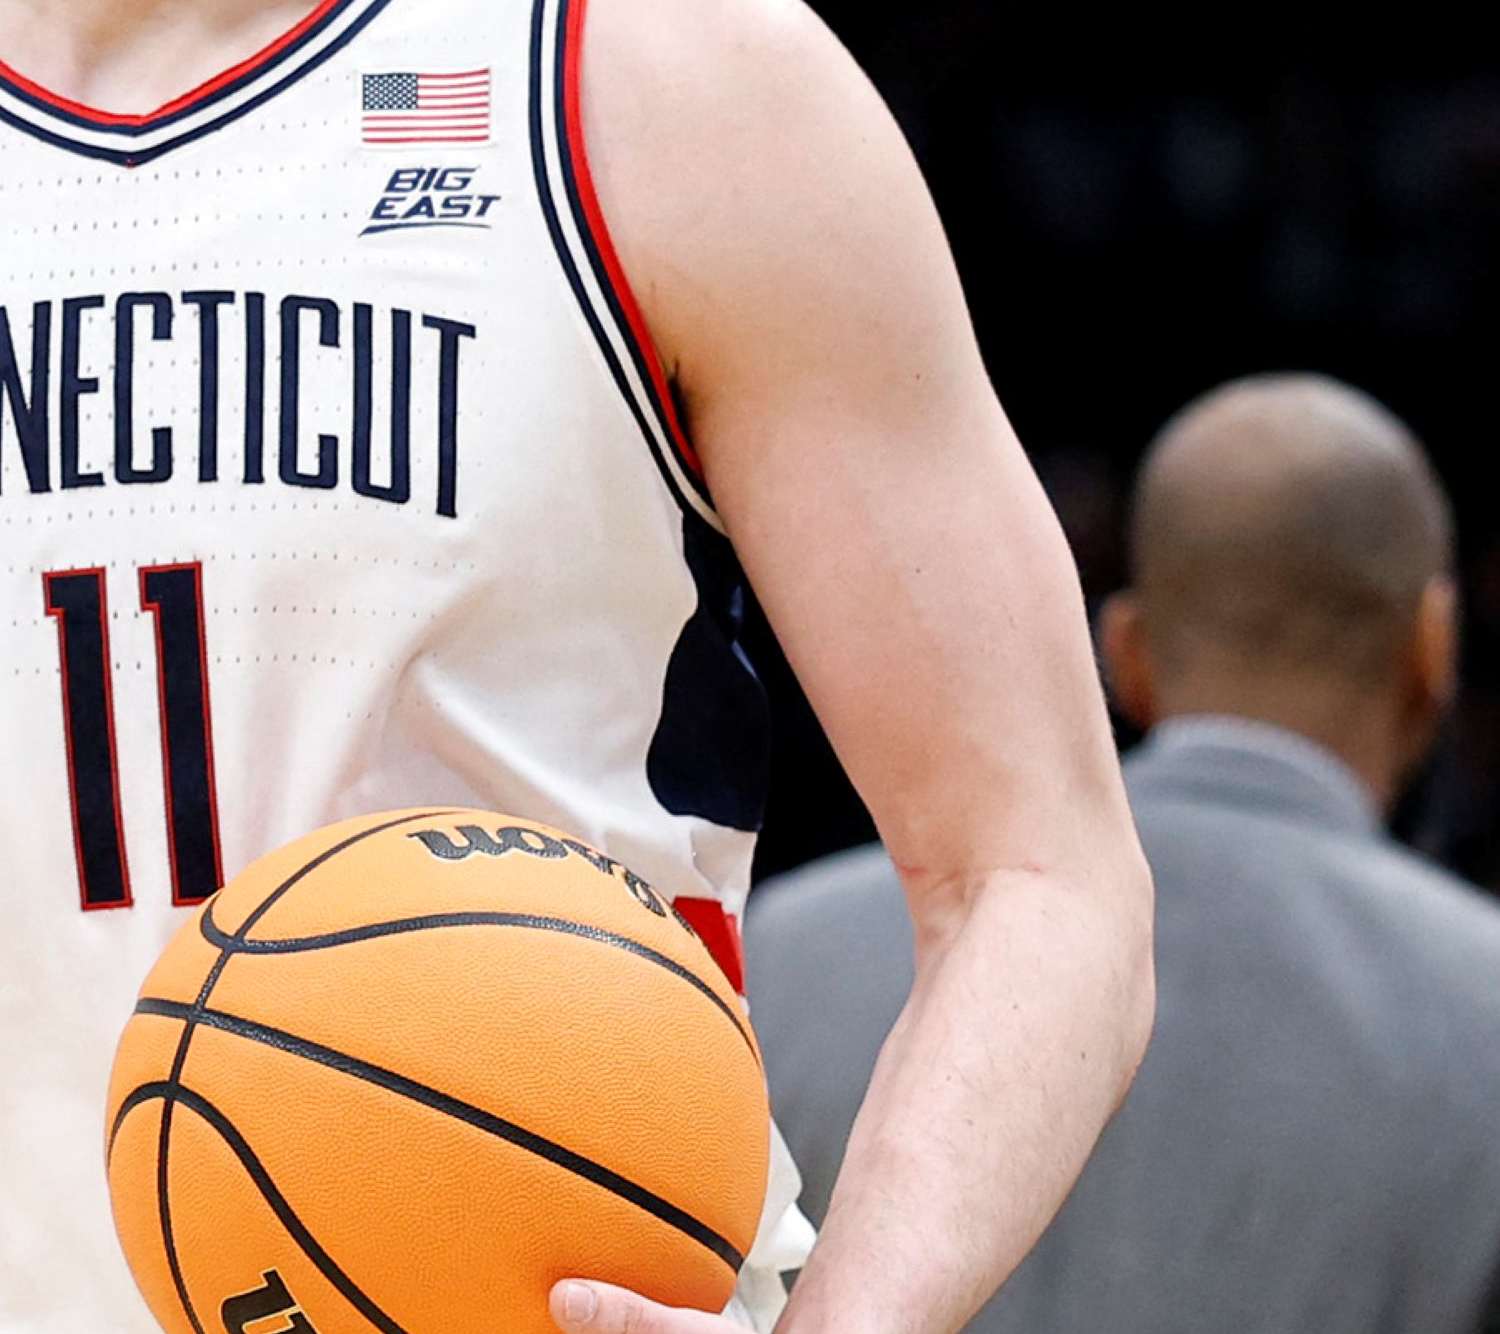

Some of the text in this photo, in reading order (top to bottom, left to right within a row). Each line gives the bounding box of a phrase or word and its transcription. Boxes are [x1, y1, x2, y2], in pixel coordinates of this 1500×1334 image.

[384, 167, 478, 194] BIG
[370, 194, 502, 221] EAST
[42, 561, 225, 910] 11
